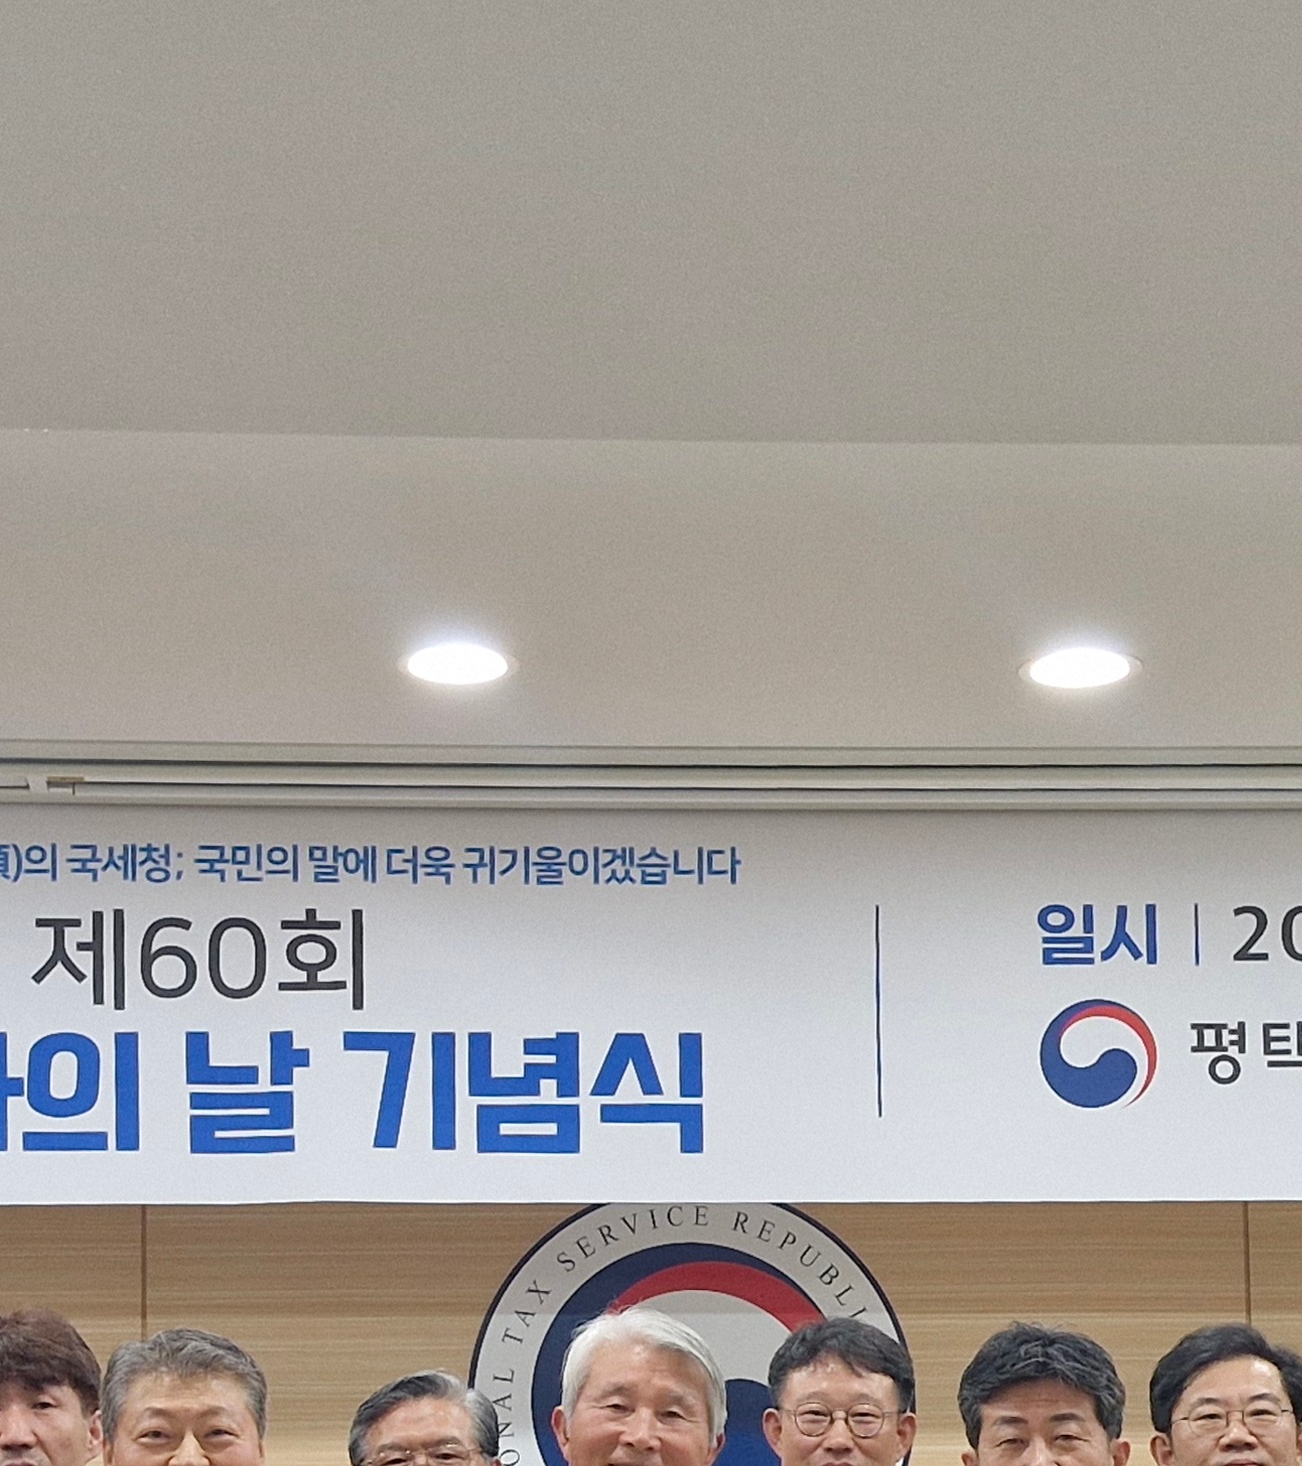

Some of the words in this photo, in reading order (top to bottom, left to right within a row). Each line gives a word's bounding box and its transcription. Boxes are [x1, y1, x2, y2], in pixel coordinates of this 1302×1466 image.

[65, 843, 185, 883] 국세청;
[193, 844, 299, 883] 국민의
[308, 845, 378, 883] 말에
[385, 847, 456, 884] 더욱
[462, 846, 742, 886] 귀기울이겠습니다
[30, 907, 365, 1011] 제60회
[1036, 902, 1158, 966] 일시
[184, 1030, 311, 1155] 날
[342, 1030, 704, 1155] 기념식
[501, 1279, 552, 1347] TAX
[556, 1205, 709, 1273] SERVICE
[732, 1207, 868, 1318] REPUBLI
